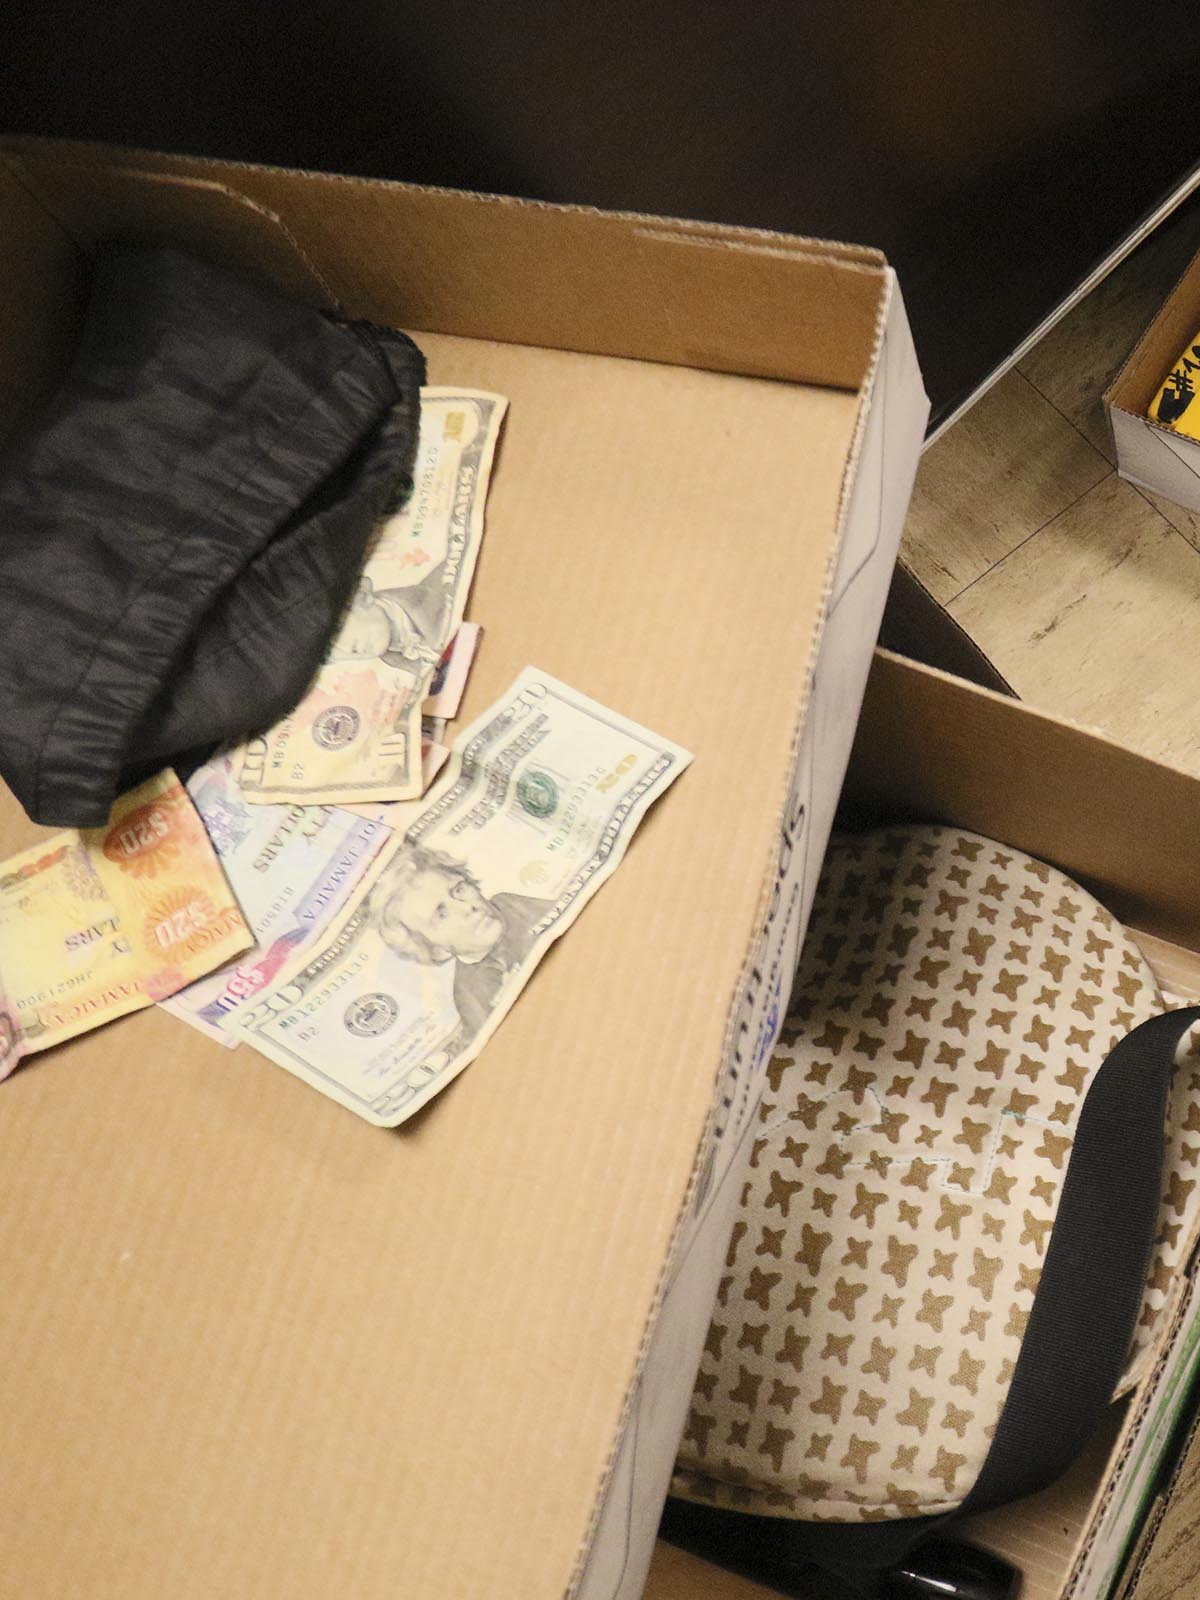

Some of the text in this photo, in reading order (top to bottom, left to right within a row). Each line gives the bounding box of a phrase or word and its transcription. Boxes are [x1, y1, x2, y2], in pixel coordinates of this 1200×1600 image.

[119, 810, 171, 857] $20
[303, 849, 361, 922] JAMAICA
[154, 899, 210, 950] $20
